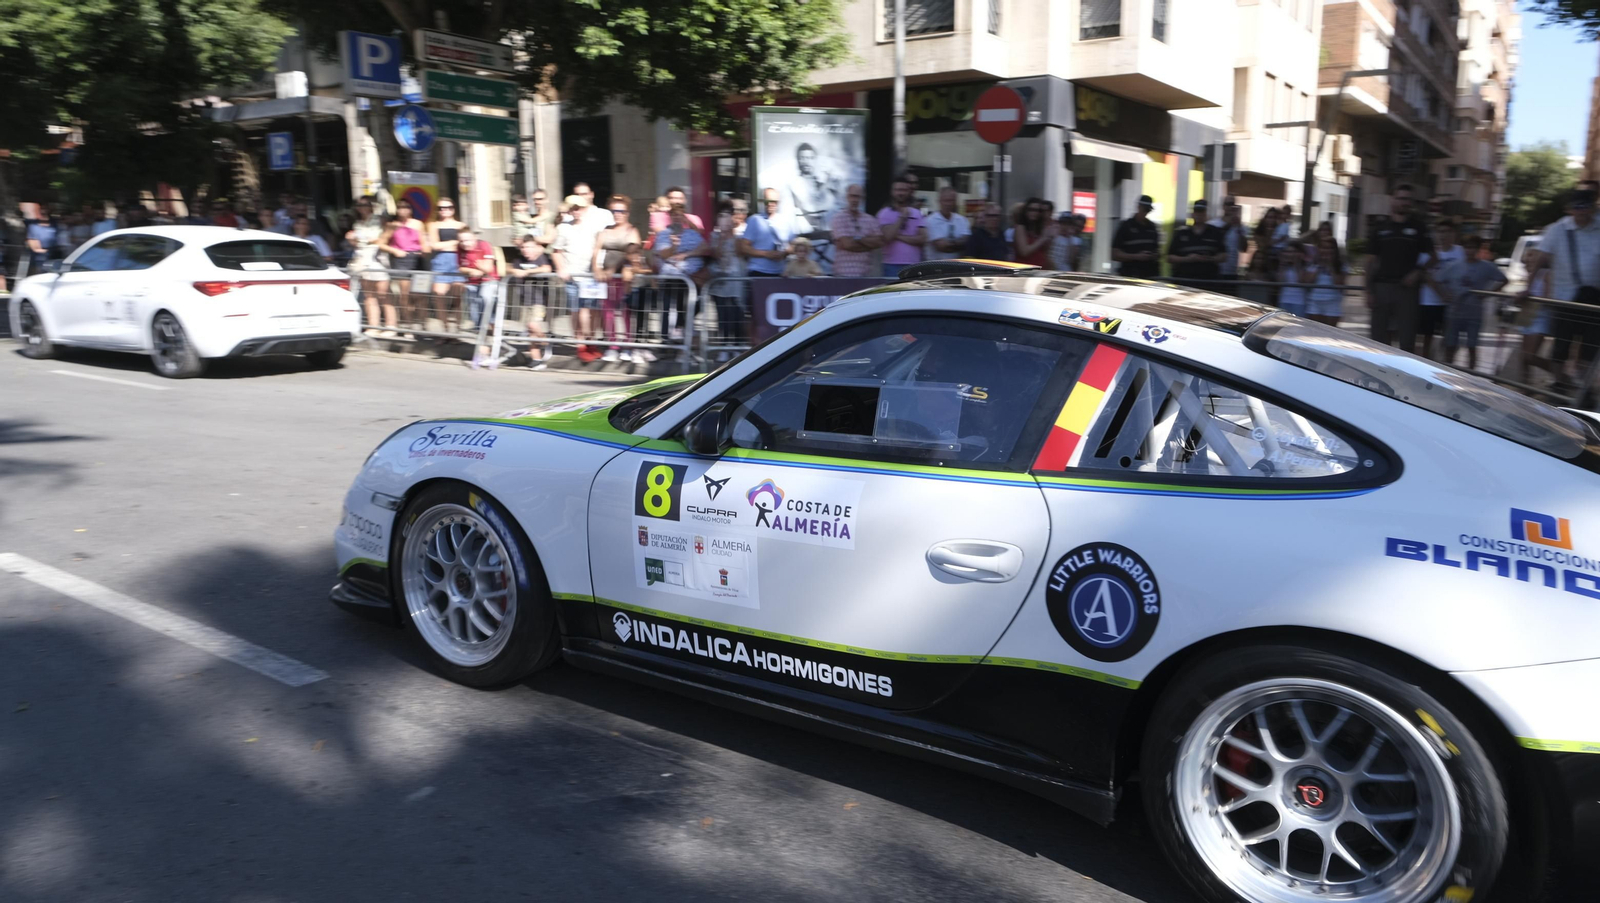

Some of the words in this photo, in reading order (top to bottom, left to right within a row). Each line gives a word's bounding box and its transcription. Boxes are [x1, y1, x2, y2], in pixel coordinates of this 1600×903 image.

[409, 426, 498, 451] Sevilla
[437, 446, 486, 460] invernaderos
[643, 464, 675, 517] 8
[687, 505, 738, 518] CUPRA
[787, 499, 833, 516] COSTA
[834, 505, 852, 518] DE
[692, 514, 711, 523] INDALO
[712, 517, 732, 525] MOTOR
[772, 515, 851, 540] ALMERÍA
[651, 533, 688, 545] DIPUTACIÓN
[711, 539, 752, 553] ALMERÍA
[711, 549, 732, 557] CIUDAD
[1049, 550, 1095, 592] LITTLE
[1097, 548, 1159, 614] WARRIORS
[632, 618, 752, 667] INDALICA
[753, 648, 893, 697] HORMIGONES
